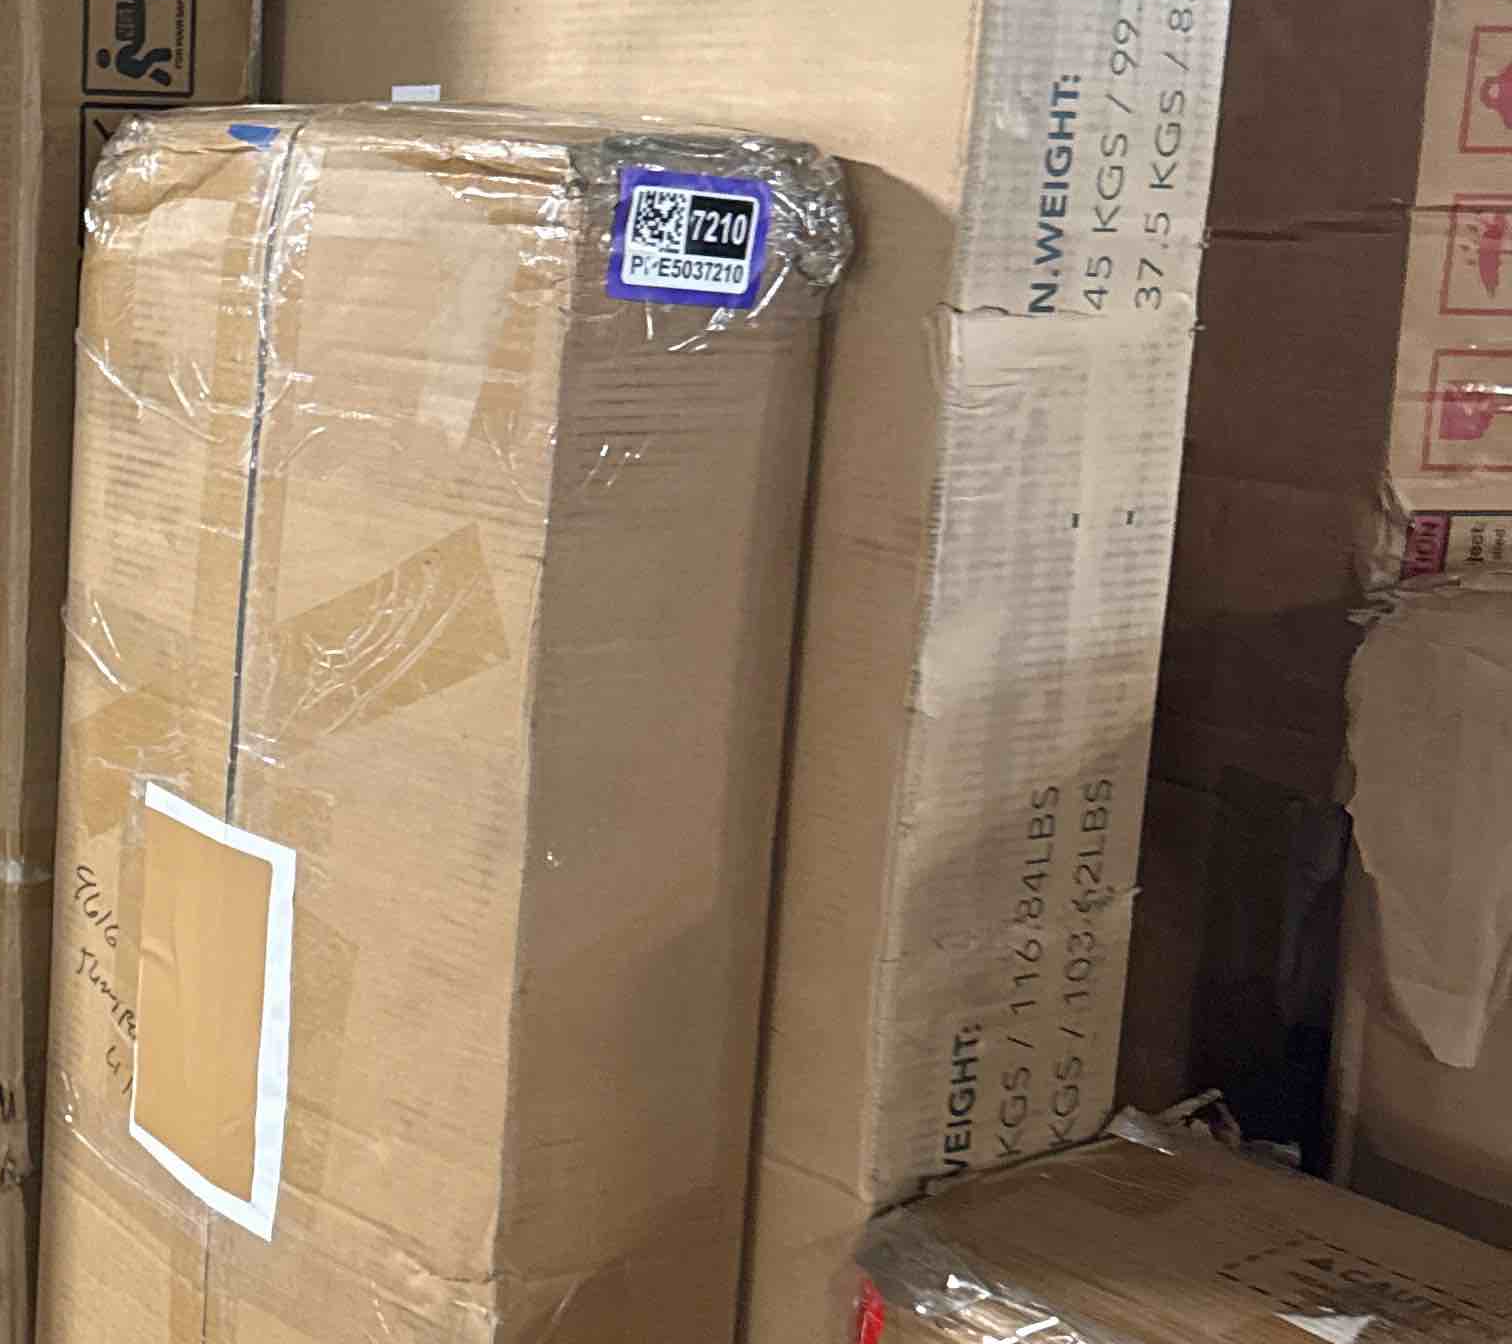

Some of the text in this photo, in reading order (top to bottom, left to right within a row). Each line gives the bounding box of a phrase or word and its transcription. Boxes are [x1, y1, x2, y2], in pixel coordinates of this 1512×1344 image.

[1108, 93, 1131, 114] /
[1149, 89, 1186, 190] KGS
[691, 210, 747, 245] 7210
[1028, 73, 1082, 314] N.WEIGHT:
[1092, 132, 1129, 234] KGS
[1084, 256, 1112, 310] 45
[1134, 211, 1172, 310] 37.5
[996, 1066, 1030, 1156] KGS
[1049, 1057, 1083, 1152] KGS
